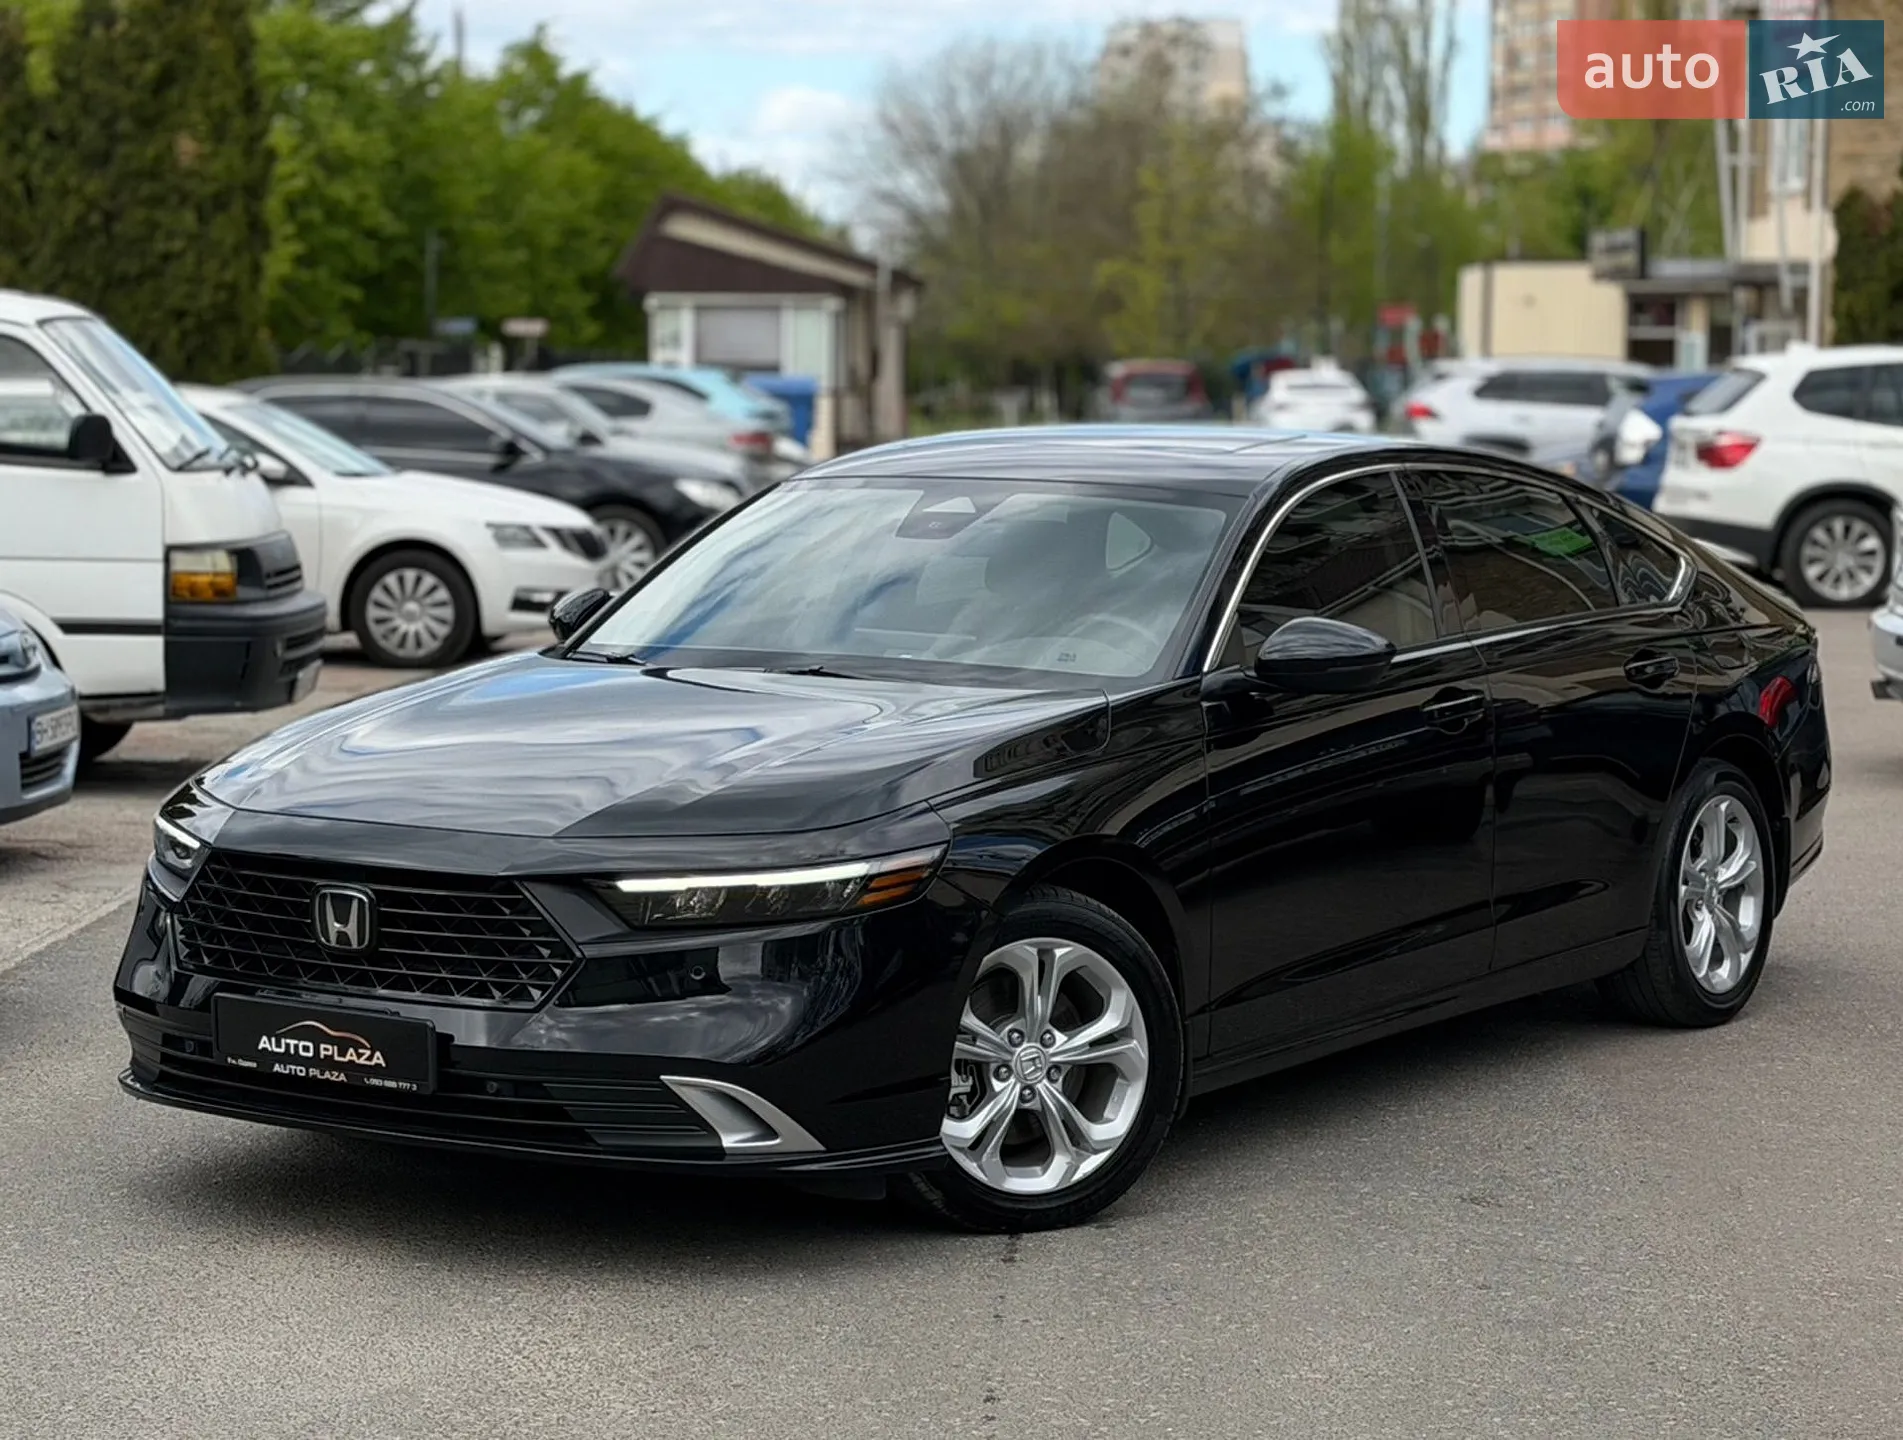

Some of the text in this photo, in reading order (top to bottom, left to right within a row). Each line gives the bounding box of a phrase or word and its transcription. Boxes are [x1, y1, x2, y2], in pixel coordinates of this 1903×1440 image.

[258, 1035, 386, 1067] AUTO PLAZA
[273, 1063, 347, 1082] AUTO PLAZA
